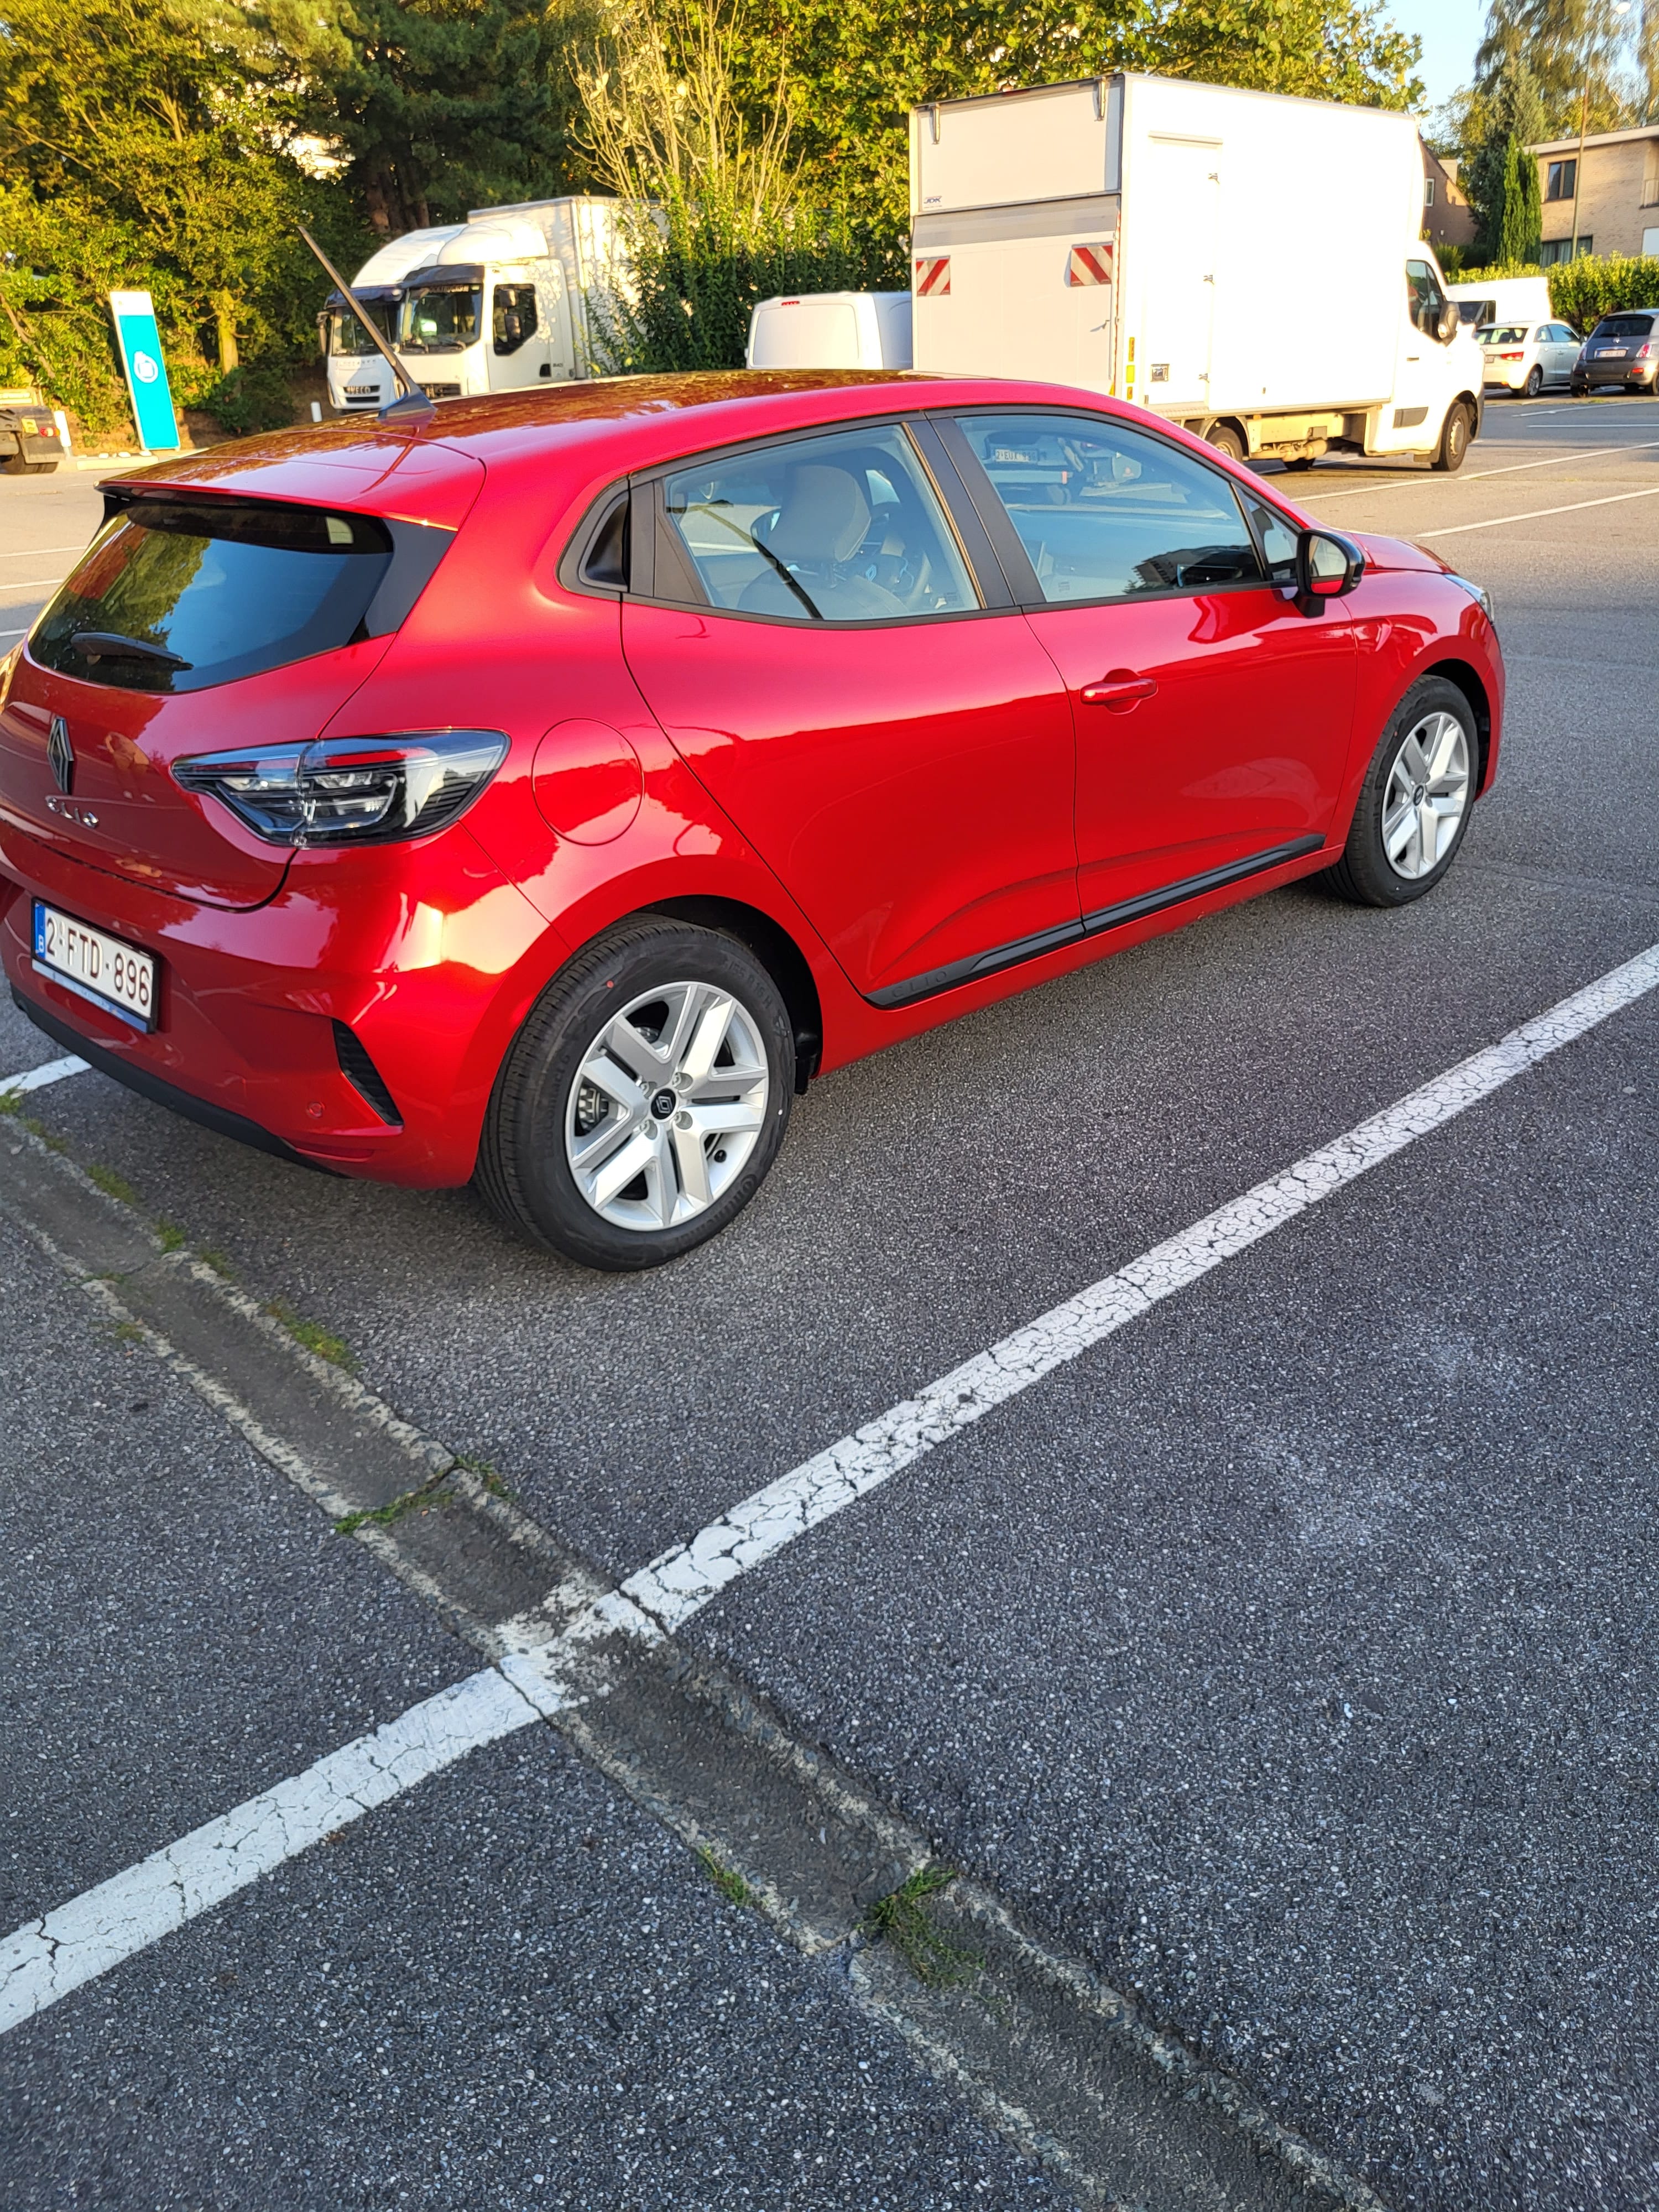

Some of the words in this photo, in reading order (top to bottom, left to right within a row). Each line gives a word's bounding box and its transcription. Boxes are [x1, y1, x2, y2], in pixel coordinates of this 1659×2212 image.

[347, 385, 371, 395] IVECO
[46, 797, 99, 828] CLIO
[38, 935, 44, 953] B
[892, 971, 947, 998] CLIO
